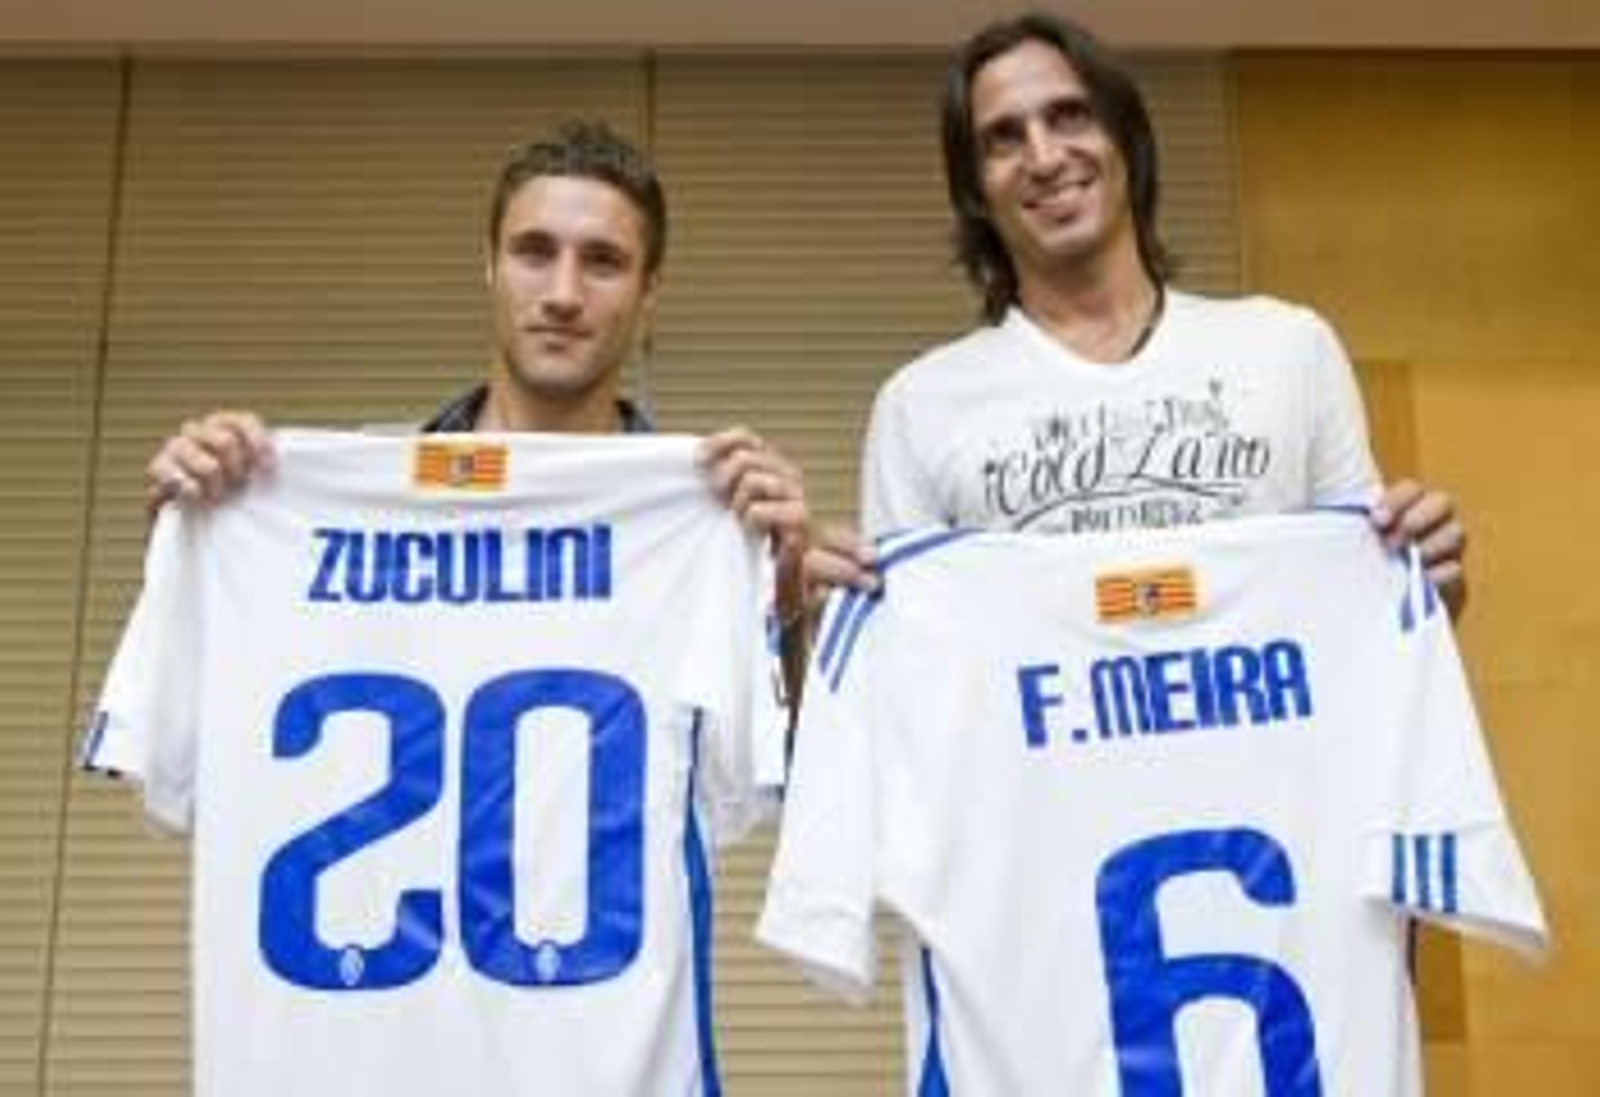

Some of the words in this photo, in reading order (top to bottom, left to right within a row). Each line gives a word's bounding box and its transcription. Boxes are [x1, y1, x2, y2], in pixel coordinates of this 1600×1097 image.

[307, 524, 612, 604] ZUCULINI
[257, 668, 648, 991] 20
[1095, 826, 1323, 1097] 6
